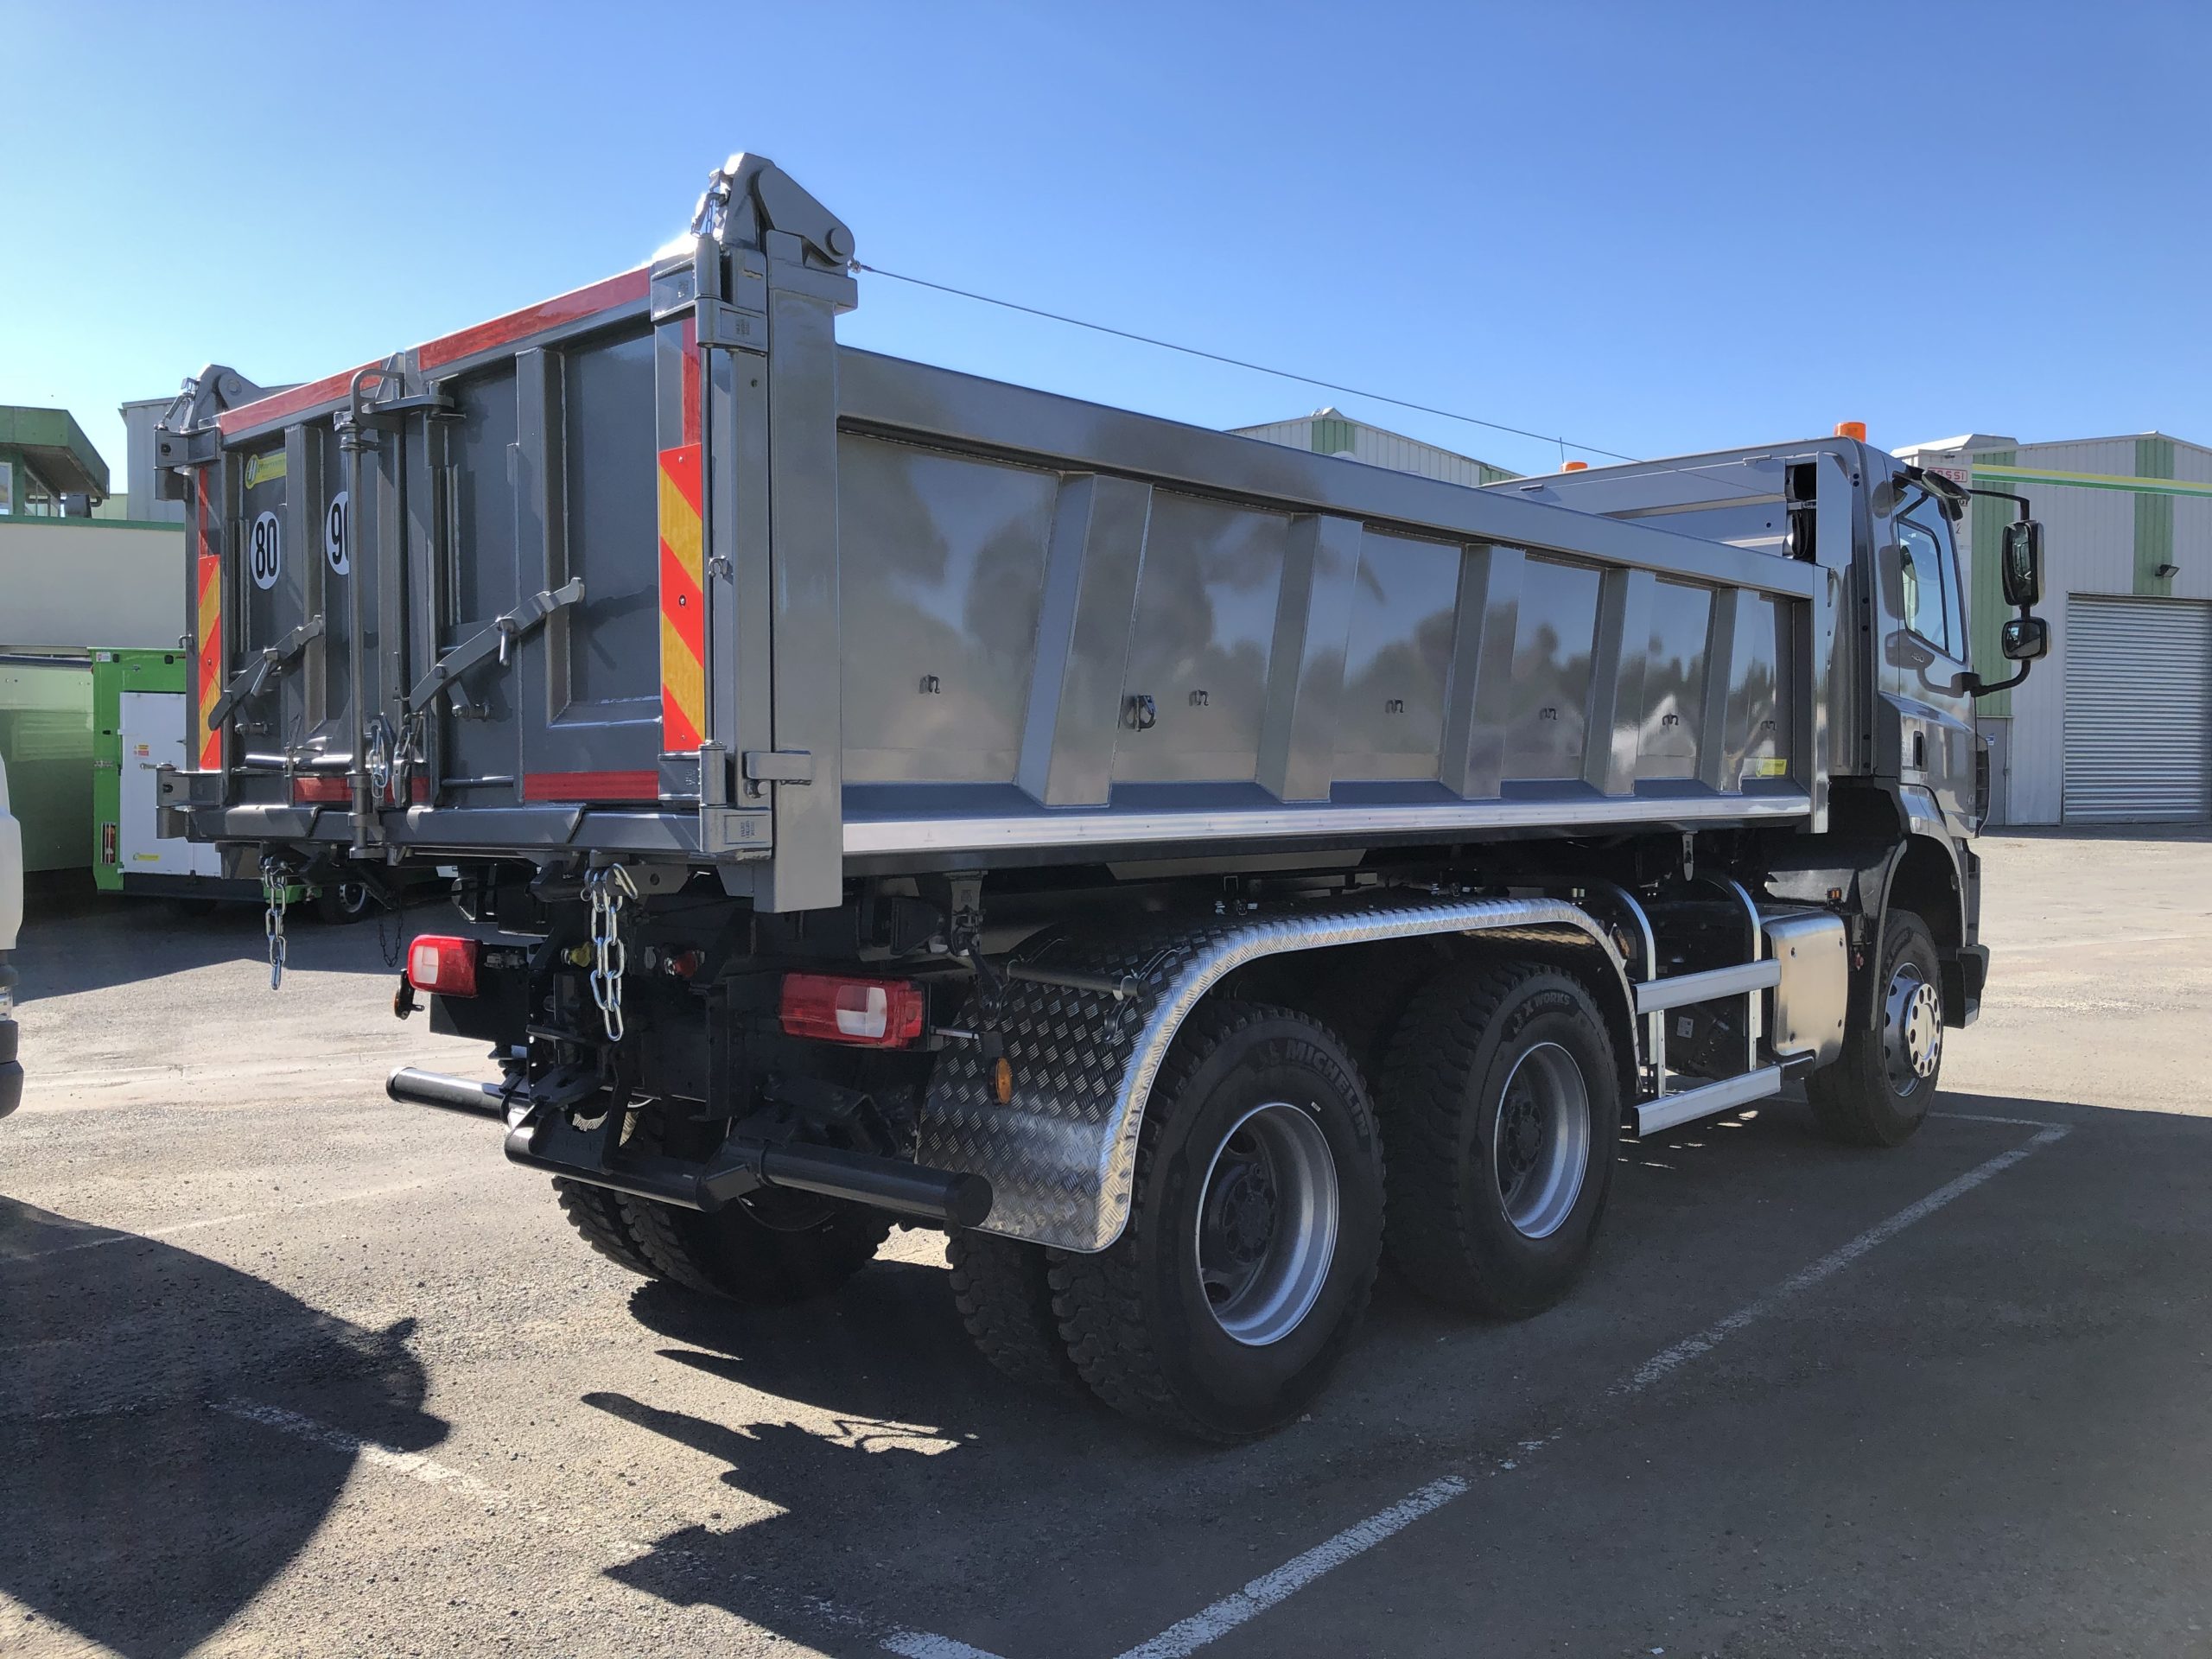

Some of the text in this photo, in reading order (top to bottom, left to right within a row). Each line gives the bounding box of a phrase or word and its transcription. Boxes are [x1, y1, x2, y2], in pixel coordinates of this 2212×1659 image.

[1929, 469, 1964, 480] SSI
[257, 518, 277, 579] 80
[1534, 992, 1571, 1007] WORKS
[1286, 1038, 1370, 1137] MICHELIN
